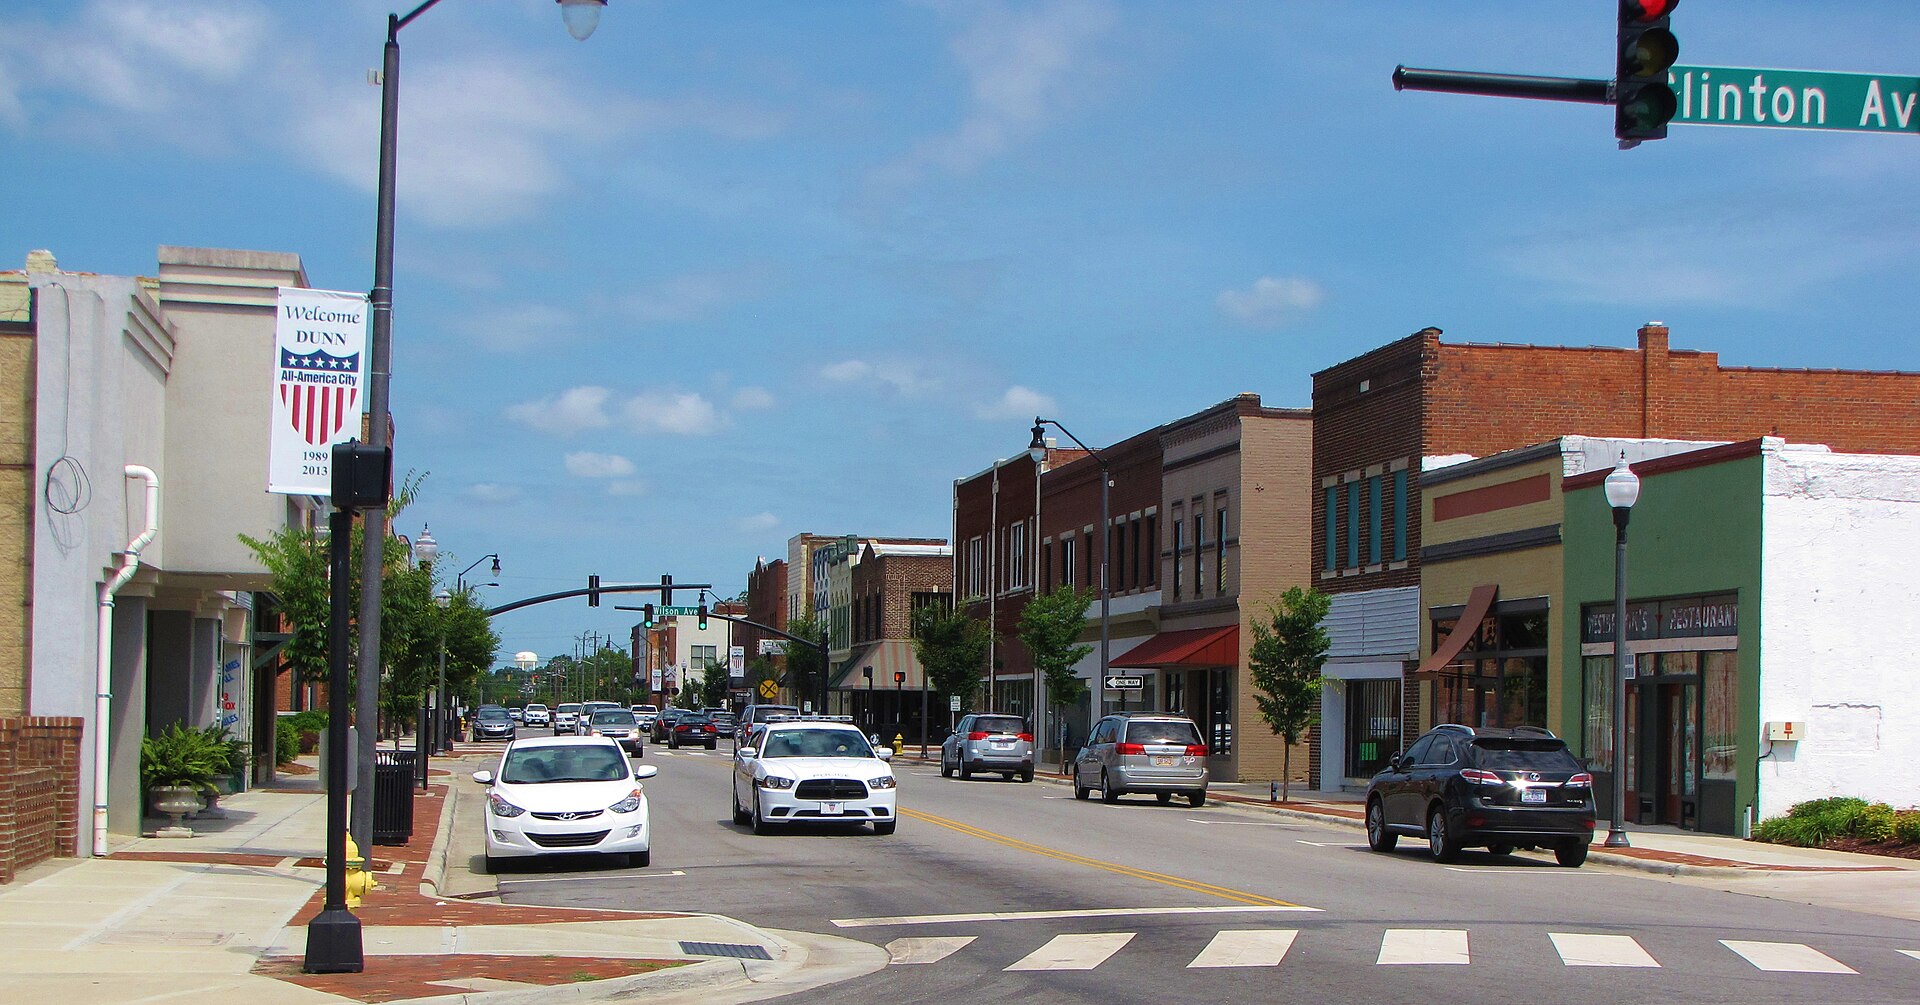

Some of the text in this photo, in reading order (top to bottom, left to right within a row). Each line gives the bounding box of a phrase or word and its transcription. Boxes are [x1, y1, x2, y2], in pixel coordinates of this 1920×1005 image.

[1668, 71, 1826, 124] linton
[286, 305, 360, 324] Welcome
[296, 330, 347, 345] DUNN
[281, 371, 357, 387] All-America City
[303, 451, 328, 461] 1989
[302, 465, 328, 476] 2013
[653, 606, 698, 615] Wilson Ave
[1669, 604, 1737, 630] RESTAURANT
